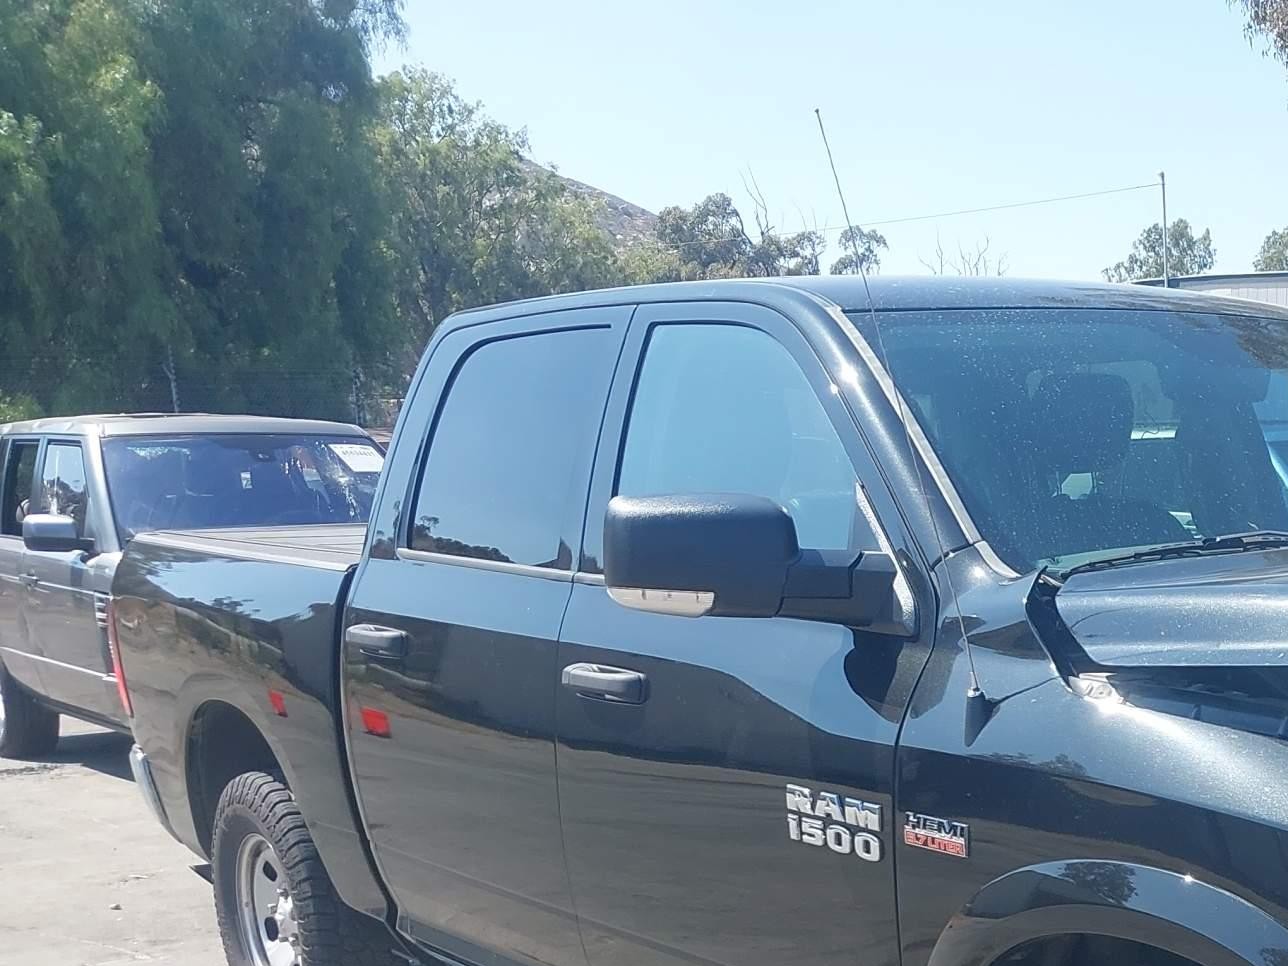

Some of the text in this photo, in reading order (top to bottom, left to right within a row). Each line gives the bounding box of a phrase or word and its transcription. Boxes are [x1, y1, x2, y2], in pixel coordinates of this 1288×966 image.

[786, 783, 881, 832] RAM
[904, 811, 969, 840] HEMI
[787, 813, 880, 862] 1500
[927, 836, 964, 854] LITER
